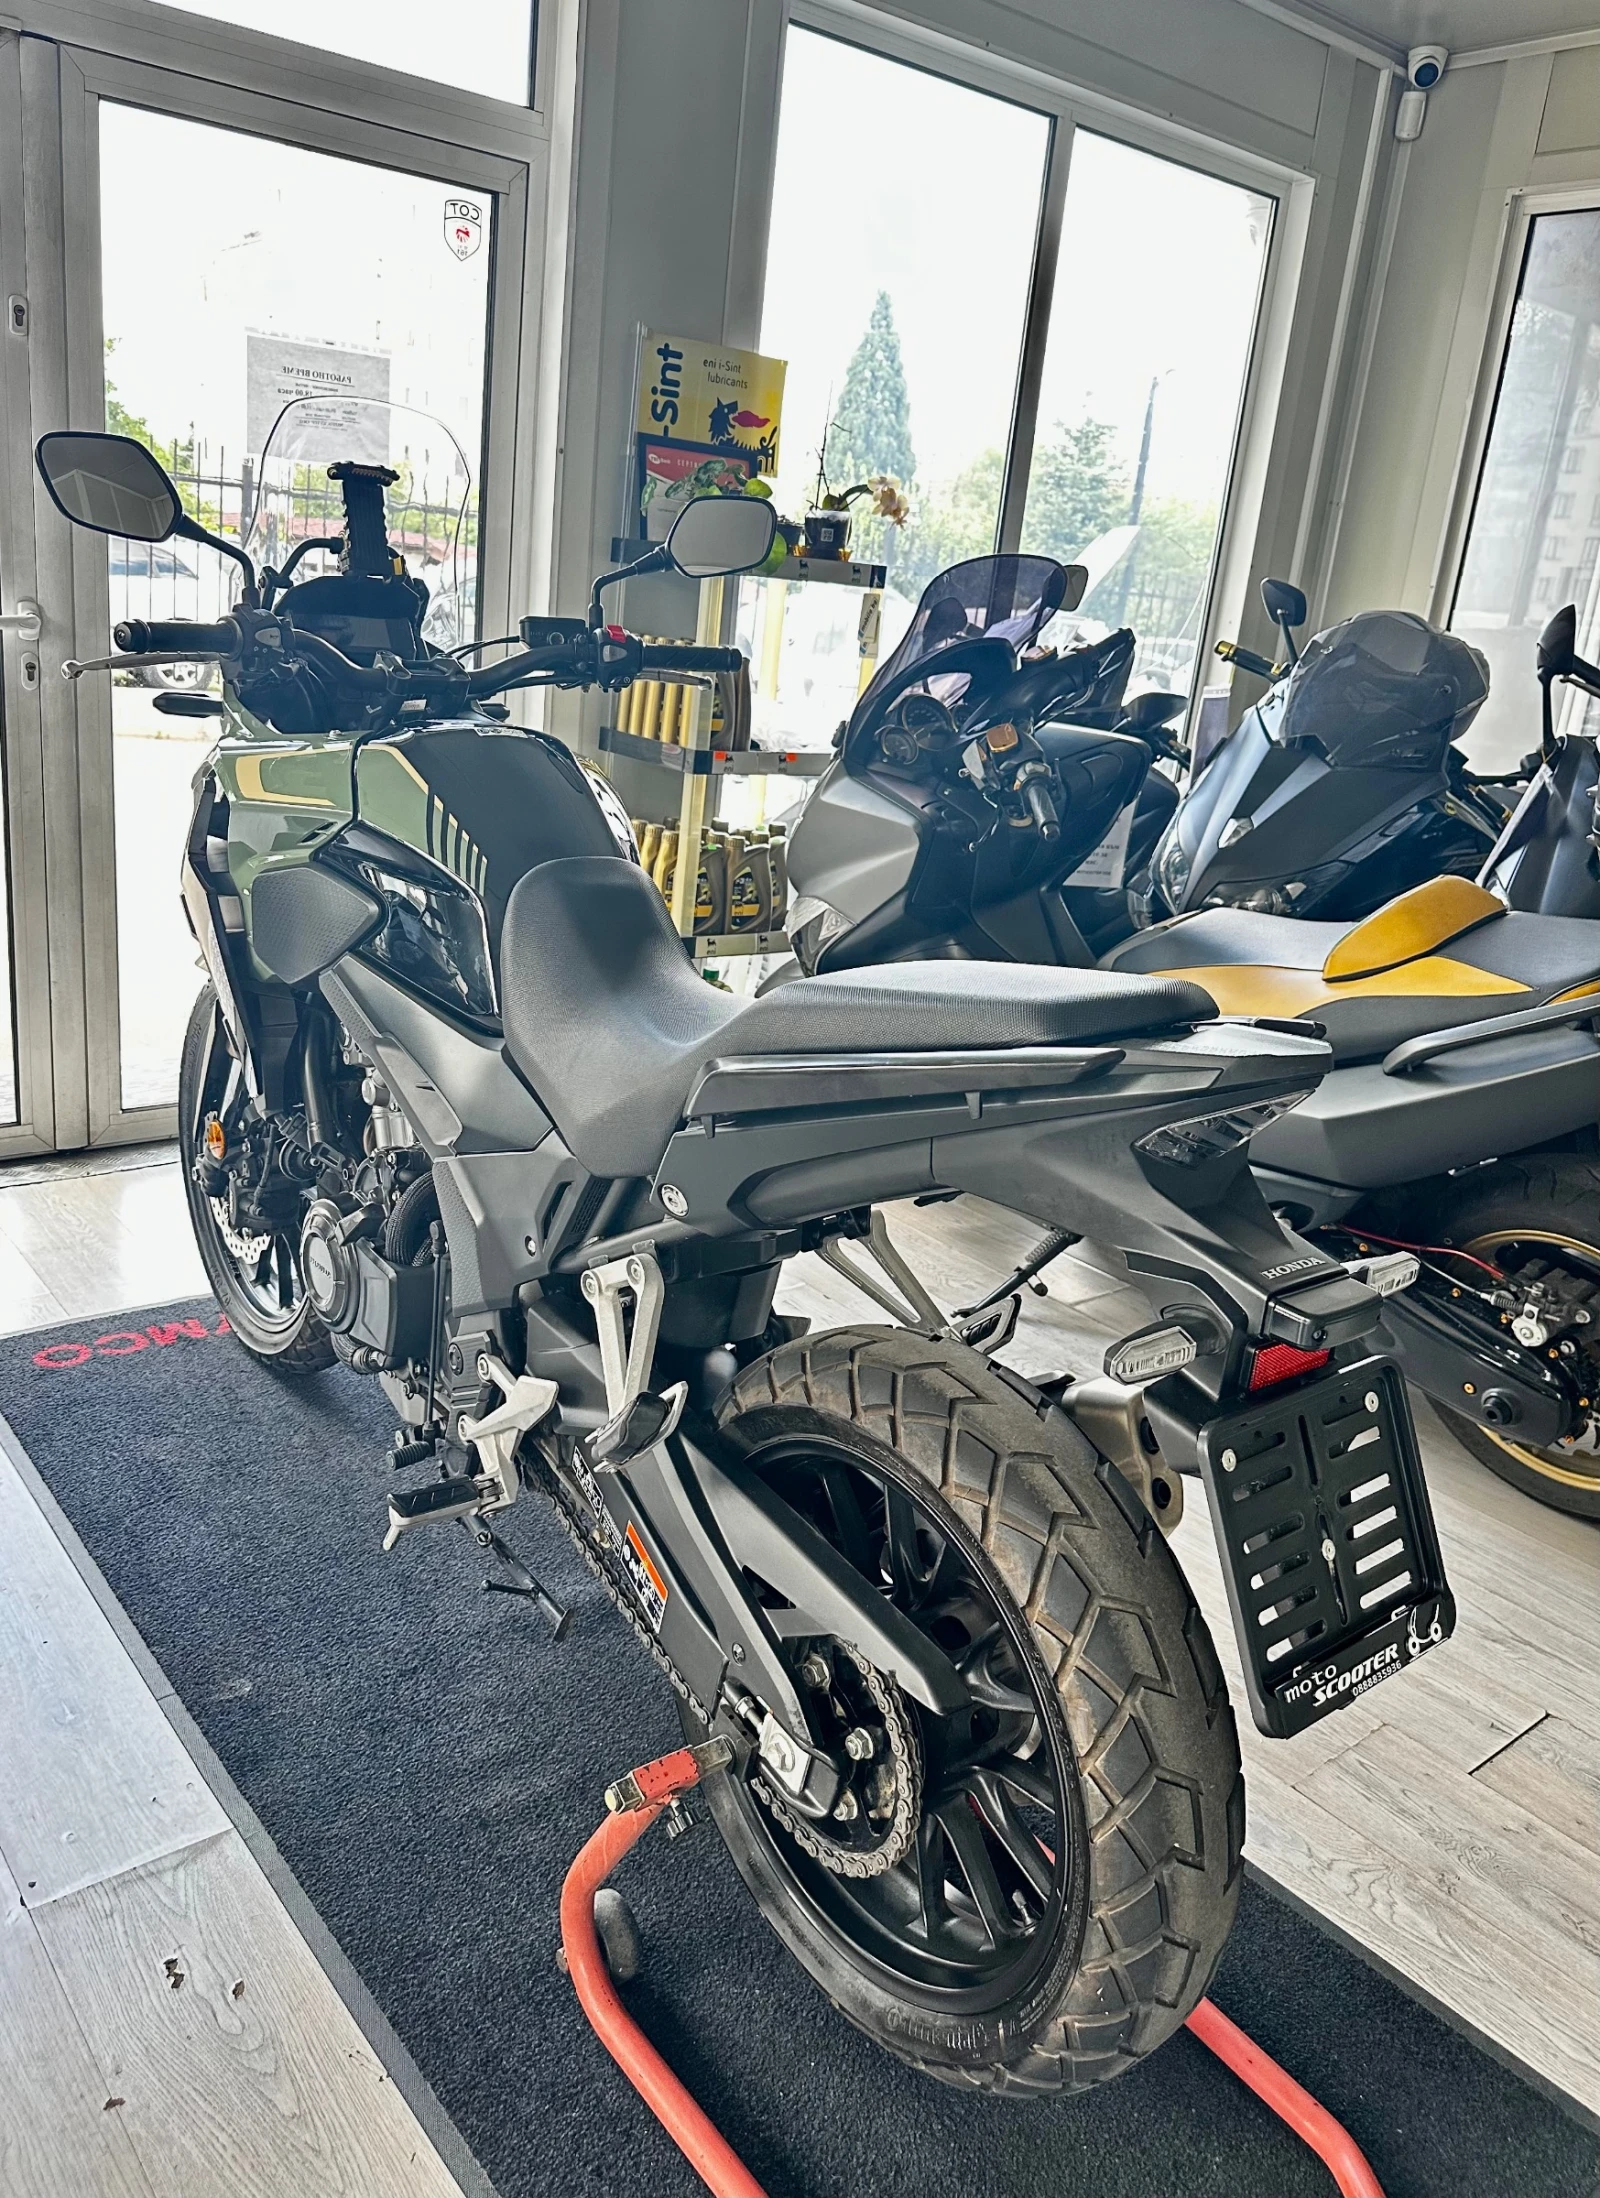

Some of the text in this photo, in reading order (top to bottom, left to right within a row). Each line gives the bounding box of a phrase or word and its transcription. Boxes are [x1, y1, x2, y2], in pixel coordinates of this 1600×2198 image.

[703, 358, 741, 373] eni i-Sint
[707, 371, 748, 389] lubricants
[1260, 1257, 1326, 1280] HONDA
[1284, 1664, 1337, 1703] moto
[1312, 1643, 1400, 1707] SCOOTER
[1352, 1660, 1402, 1697] 0888835936
